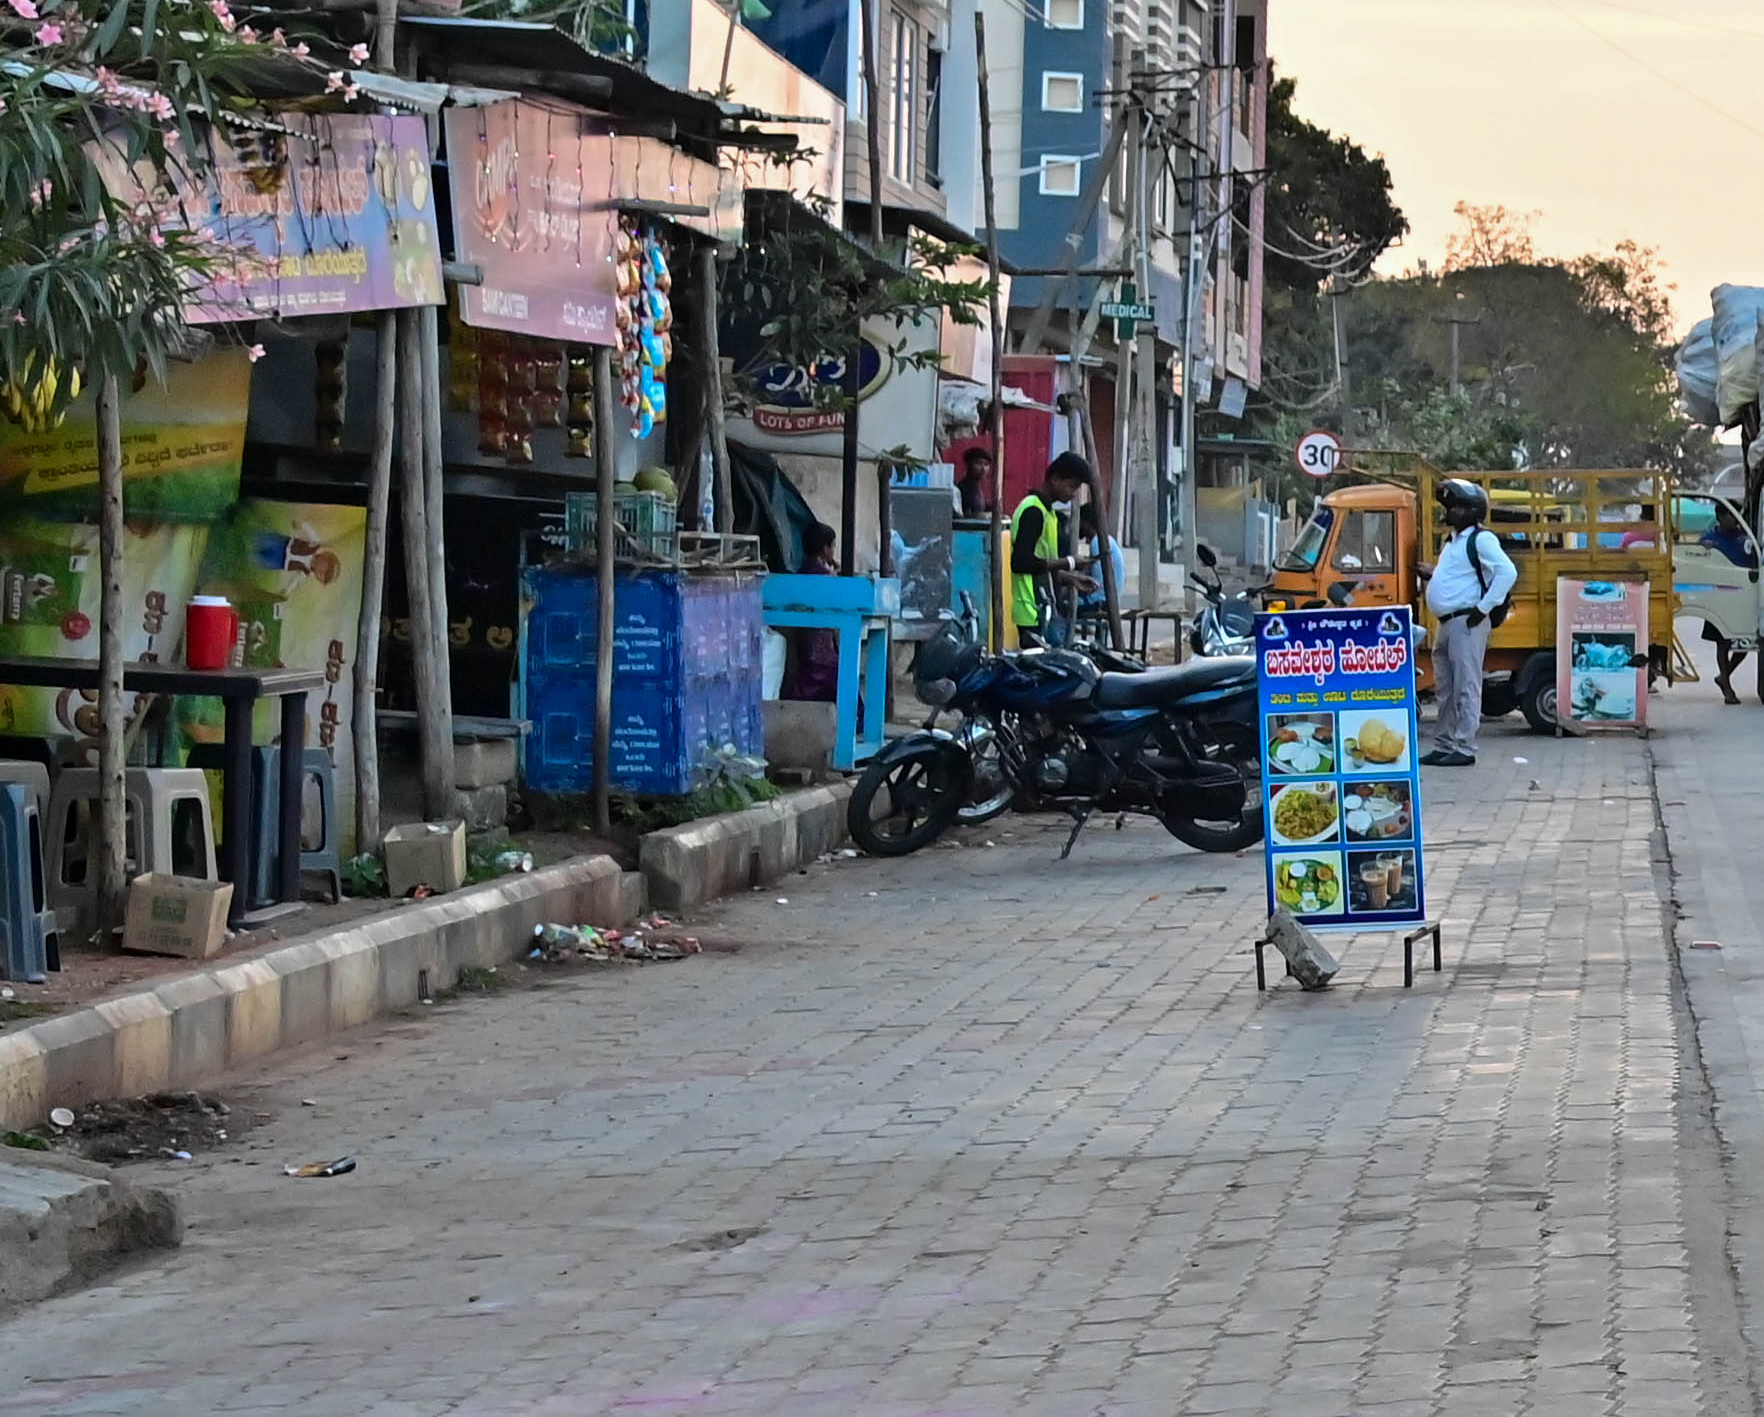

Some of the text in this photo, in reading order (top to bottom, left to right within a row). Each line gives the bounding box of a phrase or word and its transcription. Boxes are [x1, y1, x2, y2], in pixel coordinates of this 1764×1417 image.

[1101, 303, 1152, 319] MEDICAL
[760, 412, 845, 430] LOTS OF FUN
[1303, 443, 1335, 468] 30
[1265, 637, 1407, 686] ಬಸವೇಶ್ವರ ಹೋಟೆಲ್
